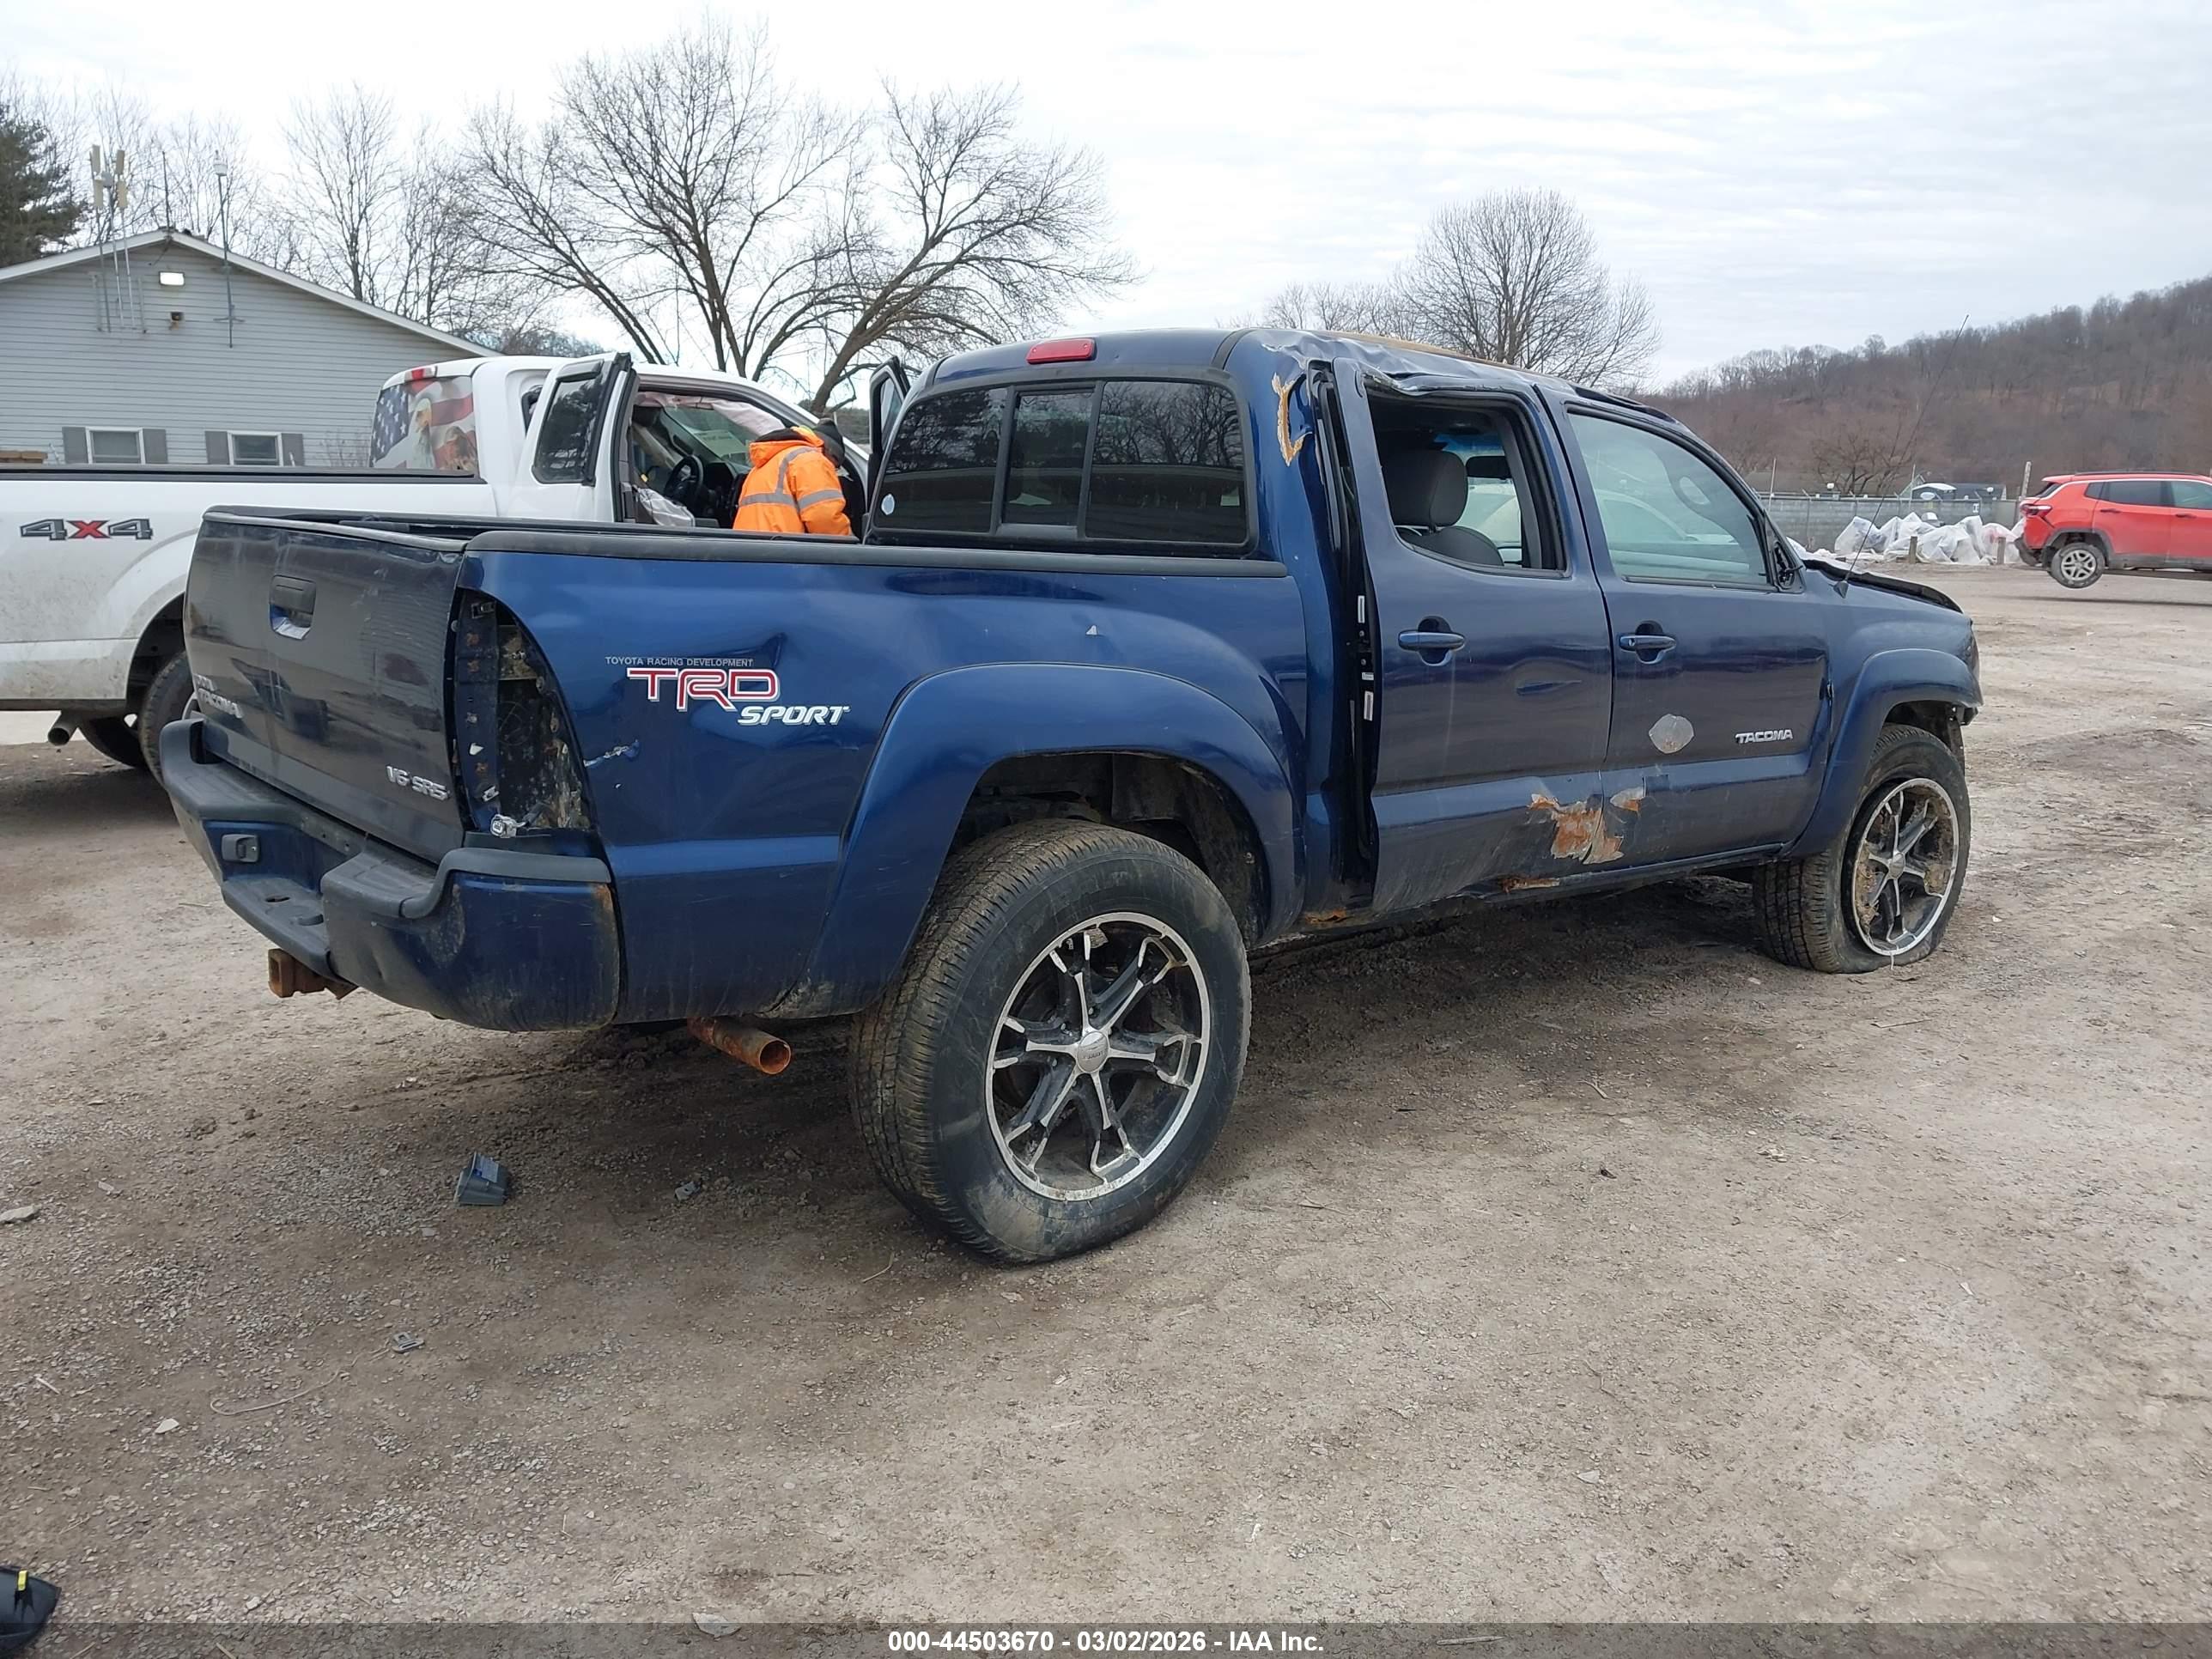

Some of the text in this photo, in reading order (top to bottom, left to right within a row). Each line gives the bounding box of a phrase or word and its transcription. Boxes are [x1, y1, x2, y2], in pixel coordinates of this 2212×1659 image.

[605, 657, 754, 667] TOYOTA RACING DEVELOPMENT
[627, 668, 781, 712] TRD
[738, 706, 851, 726] SPORT
[1735, 729, 1793, 744] TACOMA
